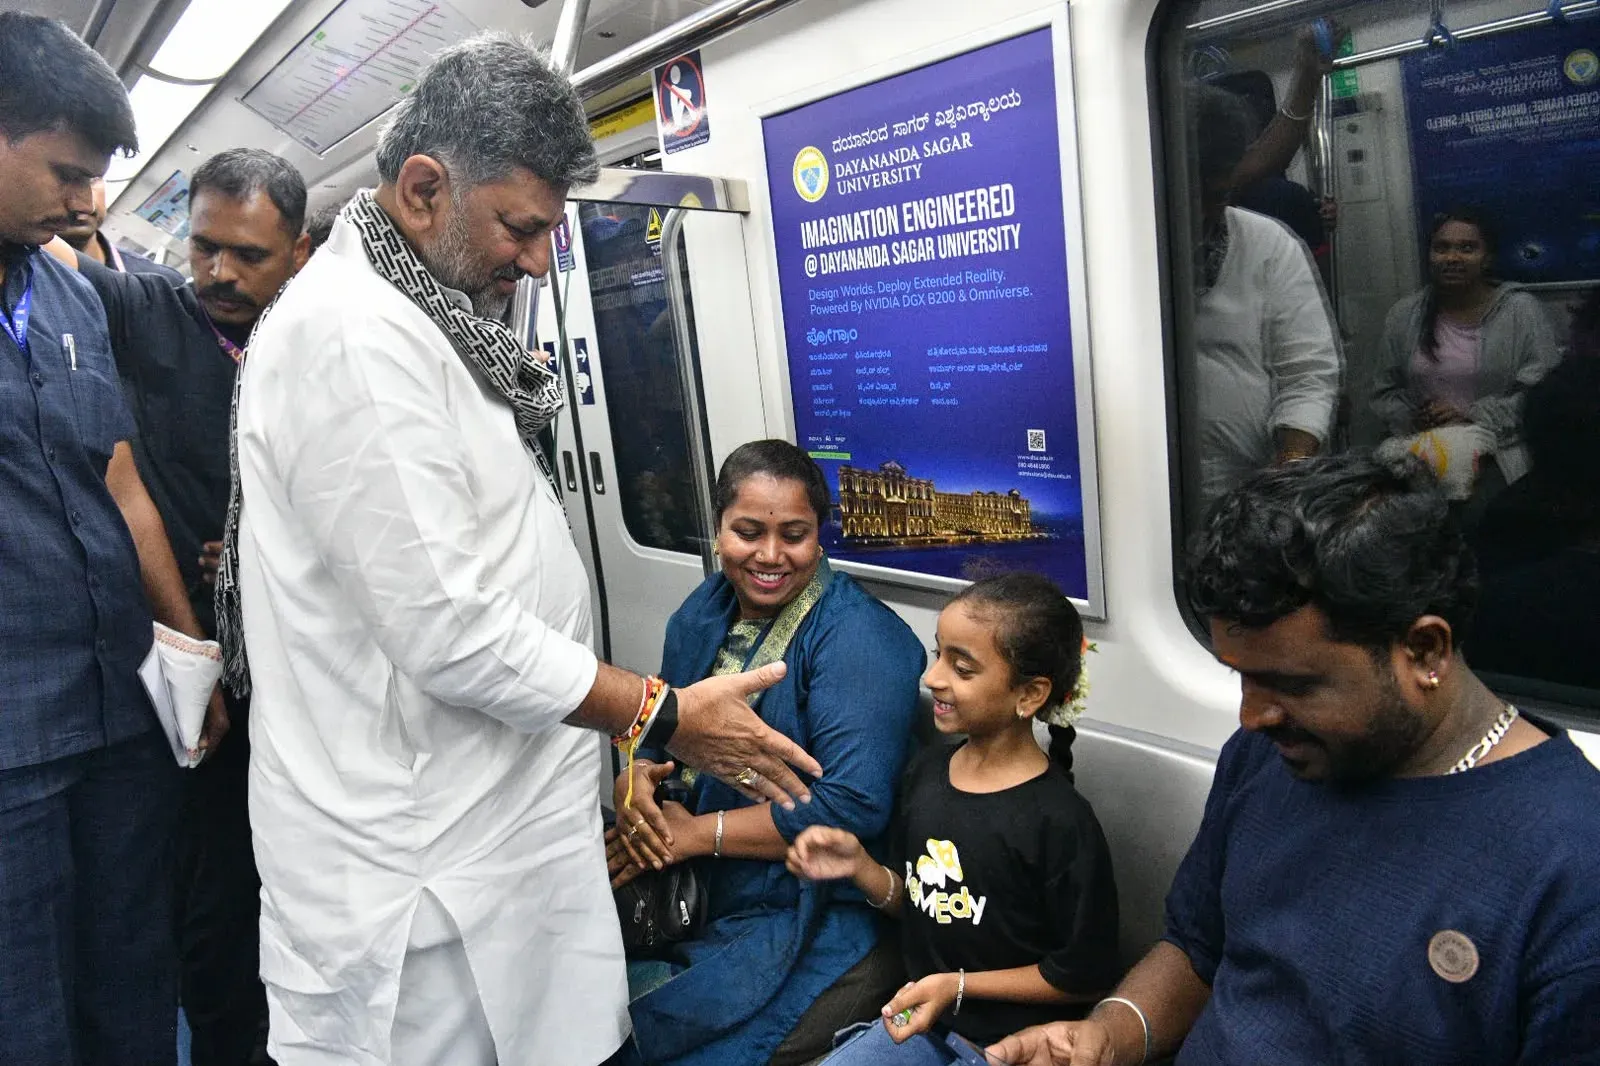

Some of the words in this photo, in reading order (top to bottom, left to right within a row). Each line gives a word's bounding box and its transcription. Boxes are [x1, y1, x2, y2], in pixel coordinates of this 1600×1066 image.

[832, 123, 889, 154] ದಯಾನಂದ
[892, 112, 930, 139] ಸಾಗರ್
[934, 87, 1022, 129] ವಿಶ್ವವಿದ್ಯಾಲಯ
[835, 144, 920, 179] DAYANANDA
[922, 132, 973, 158] SAGAR
[836, 163, 923, 195] UNIVERSITY
[800, 204, 899, 250] IMAGINATION
[902, 183, 1015, 233] ENGINEERED
[804, 253, 818, 278] @
[820, 243, 890, 275] DAYANANDA
[892, 236, 935, 265] SAGAR
[937, 223, 1021, 259] UNIVERSITY
[808, 287, 839, 302] Design
[840, 282, 876, 297] Worlds.
[878, 279, 911, 296] Deploy
[914, 273, 963, 291] Extended
[965, 268, 1006, 287] Reality.
[810, 301, 849, 315] Powered
[851, 300, 863, 314] By
[865, 296, 900, 311] NVIDIA
[902, 293, 925, 308] DGX
[928, 290, 956, 304] B200
[958, 289, 967, 302] &
[969, 284, 1033, 301] Omniverse.
